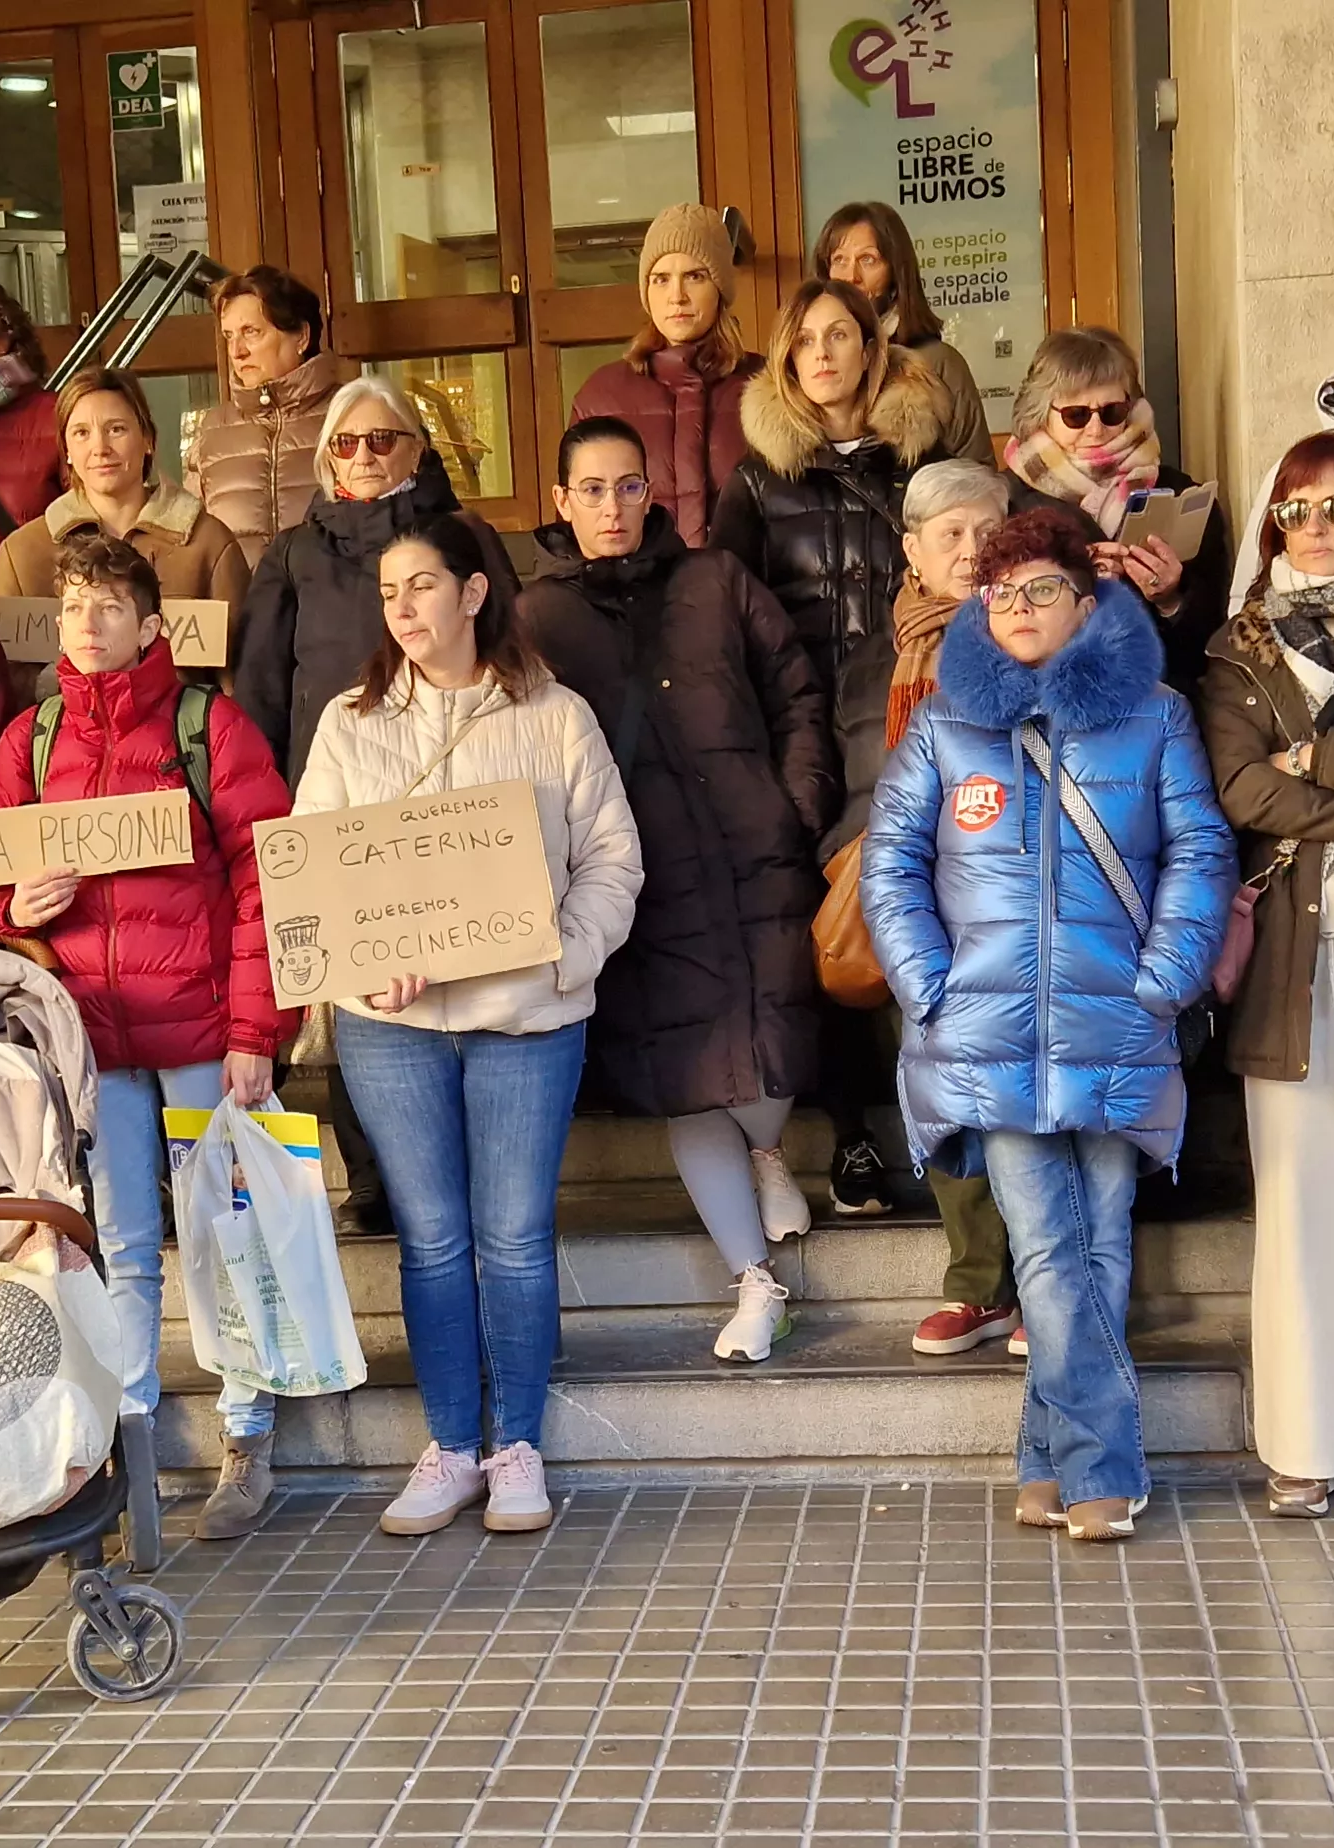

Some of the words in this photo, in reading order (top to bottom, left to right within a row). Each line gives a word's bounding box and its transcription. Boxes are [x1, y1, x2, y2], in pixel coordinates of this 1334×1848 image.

[118, 97, 154, 114] DEA
[897, 126, 993, 158] espacio
[898, 153, 975, 180] LIBRE
[984, 158, 1005, 174] de
[184, 196, 206, 205] PREV
[899, 176, 1006, 205] HUMOS
[914, 239, 925, 250] n
[932, 228, 1006, 253] espacio
[918, 256, 937, 269] ue
[943, 248, 1007, 269] respira
[934, 267, 1008, 292] espacio
[956, 784, 999, 811] UGT
[336, 820, 364, 836] NO
[400, 797, 499, 823] QUEREMOS
[38, 806, 191, 866] PERSONAL
[339, 828, 514, 866] CATERING
[354, 897, 460, 925] QUEREMOS
[350, 910, 535, 967] COCINER@S
